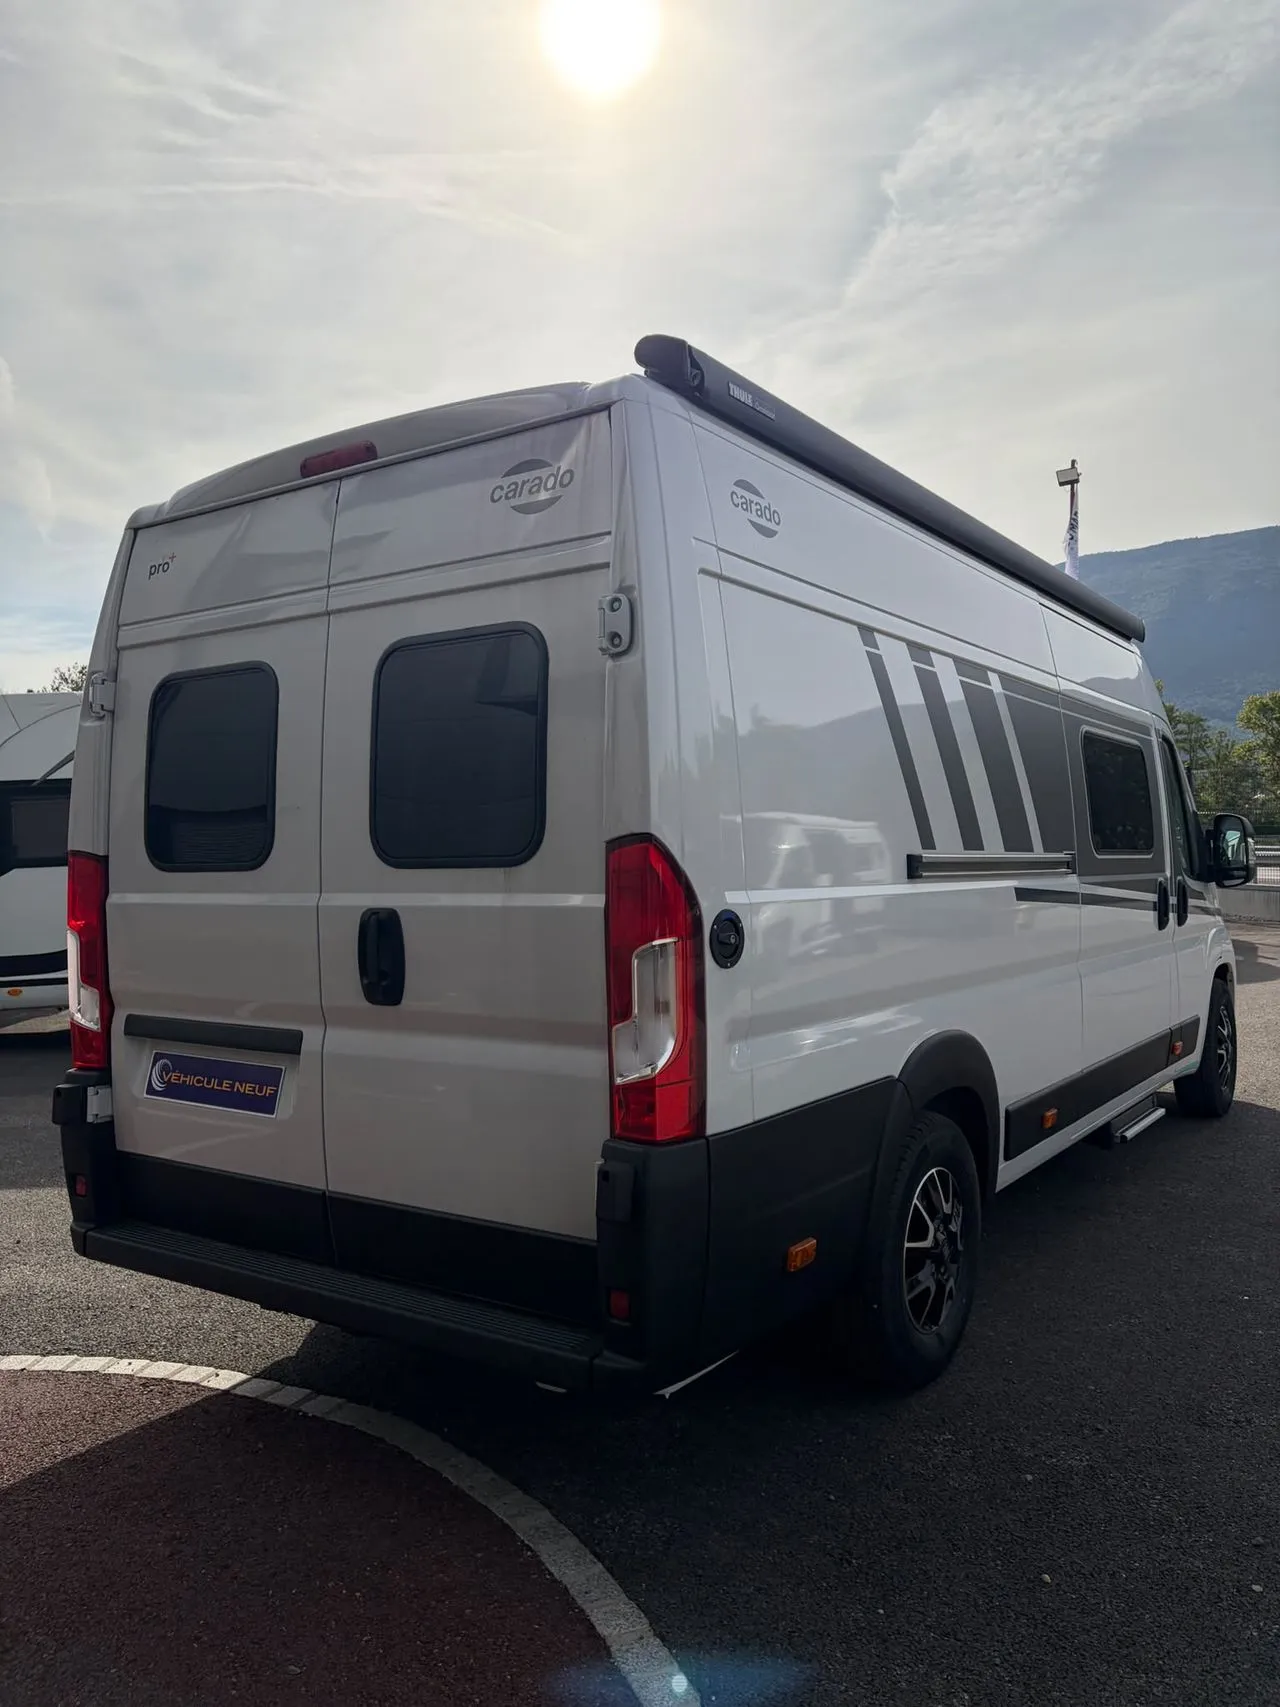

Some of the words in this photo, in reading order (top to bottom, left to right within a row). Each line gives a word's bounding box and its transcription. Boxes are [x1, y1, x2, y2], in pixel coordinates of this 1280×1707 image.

[728, 382, 754, 407] THULE
[490, 463, 575, 504] carado
[730, 489, 782, 527] carado
[162, 1071, 233, 1092] VÉHICULE
[233, 1081, 277, 1097] NEUF
